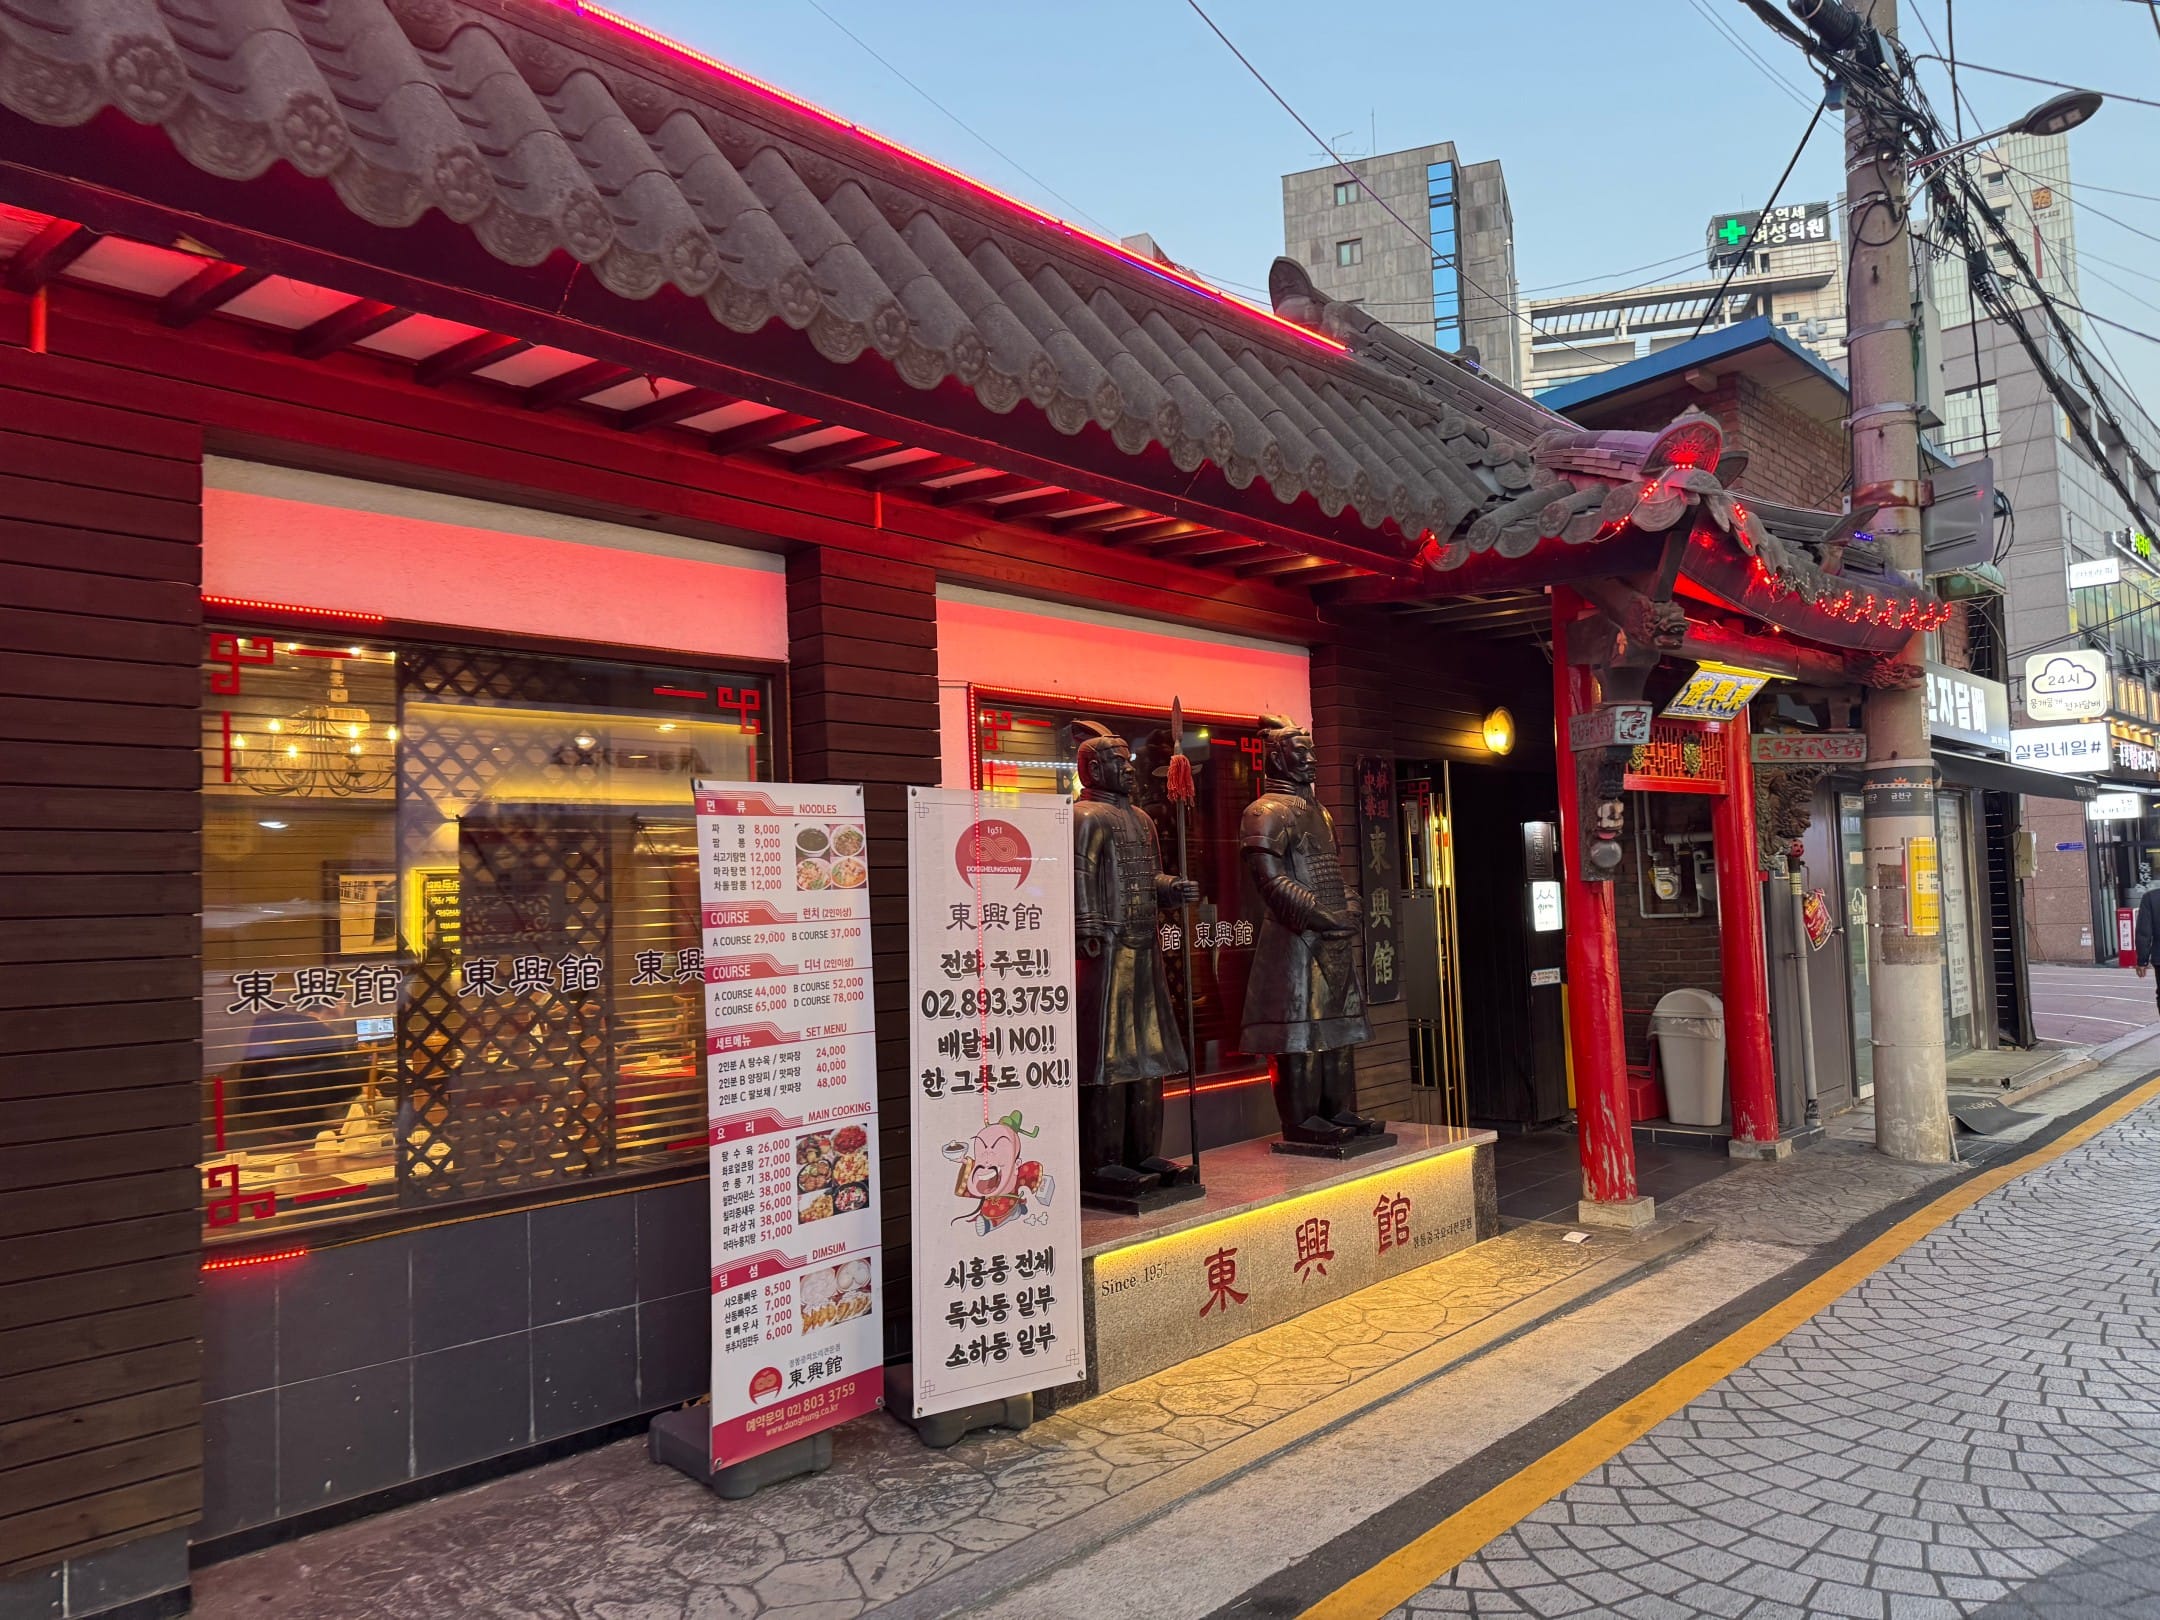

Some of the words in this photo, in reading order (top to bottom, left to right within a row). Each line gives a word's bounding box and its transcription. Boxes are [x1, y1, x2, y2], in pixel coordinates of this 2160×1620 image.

[2048, 673, 2079, 686] 24시
[799, 804, 837, 814] NOODLES
[754, 824, 780, 835] 8,000
[755, 838, 780, 849] 9,000
[750, 852, 781, 863] 12,000
[751, 866, 781, 877] 12,000
[751, 880, 782, 891] 12,000
[803, 907, 819, 918] 런치
[1368, 825, 1395, 985] 東興館
[711, 911, 750, 924] COURSE
[946, 902, 1043, 931] 東興館
[713, 937, 718, 946] A
[720, 935, 751, 946] COURSE
[754, 932, 786, 944] 29,000
[792, 932, 797, 941] B
[799, 930, 829, 940] COURSE
[831, 927, 861, 939] 37,000
[1194, 919, 1254, 948] 東興館
[712, 965, 751, 979] COURSE
[804, 959, 821, 970] 디너
[940, 949, 984, 978] 전화
[990, 949, 1050, 978] 주문!!
[458, 953, 603, 998] 東興館
[227, 964, 402, 1015] 東興館
[714, 992, 720, 1001] A
[721, 989, 753, 1000] COURSE
[755, 984, 786, 997] 44,000
[793, 984, 798, 993] B
[800, 981, 830, 992] COURSE
[832, 977, 864, 989] 52,000
[715, 1007, 720, 1016] C
[721, 1004, 753, 1016] COURSE
[755, 999, 787, 1012] 65,000
[793, 999, 799, 1007] D
[800, 996, 830, 1007] COURSE
[833, 991, 864, 1003] 78,000
[921, 985, 1069, 1019] 02.893.3759
[806, 1026, 821, 1037] SET
[823, 1023, 847, 1035] MENU
[716, 1034, 751, 1050] 세트메뉴
[938, 1026, 1002, 1060] 배달비
[1009, 1025, 1056, 1053] NO!!
[739, 1059, 746, 1070] A
[816, 1044, 846, 1058] 24,000
[740, 1075, 746, 1085] B
[747, 1071, 770, 1084] 양장피
[816, 1060, 846, 1073] 40,000
[921, 1067, 946, 1097] 한
[1025, 1059, 1070, 1087] OK!!
[740, 1091, 746, 1101] C
[817, 1075, 847, 1088] 48,000
[808, 1109, 830, 1122] MAIN
[832, 1102, 871, 1117] COOKING
[758, 1138, 790, 1154] 26,000
[758, 1153, 791, 1168] 27,000
[759, 1167, 791, 1183] 38,000
[759, 1181, 791, 1197] 38,000
[760, 1196, 792, 1212] 56,000
[760, 1210, 792, 1227] 38,000
[760, 1224, 792, 1242] 51,000
[812, 1242, 846, 1260] DIMSUM
[1199, 1192, 1411, 1318] 東興館
[1014, 1245, 1055, 1278] 전체
[1101, 1276, 1137, 1297] Since
[1144, 1261, 1169, 1283] 1951
[764, 1280, 791, 1297] 8,500
[765, 1294, 791, 1311] 7,000
[945, 1294, 1010, 1330] 독산동
[1016, 1285, 1056, 1318] 일부
[765, 1309, 792, 1326] 7,000
[766, 1323, 793, 1340] 6,000
[945, 1330, 1010, 1368] 소하동
[1016, 1323, 1056, 1357] 일부
[788, 1355, 843, 1390] 東興館
[746, 1407, 785, 1433] 예약문의
[787, 1402, 802, 1418] 02)
[803, 1393, 825, 1413] 803
[828, 1382, 856, 1403] 3759
